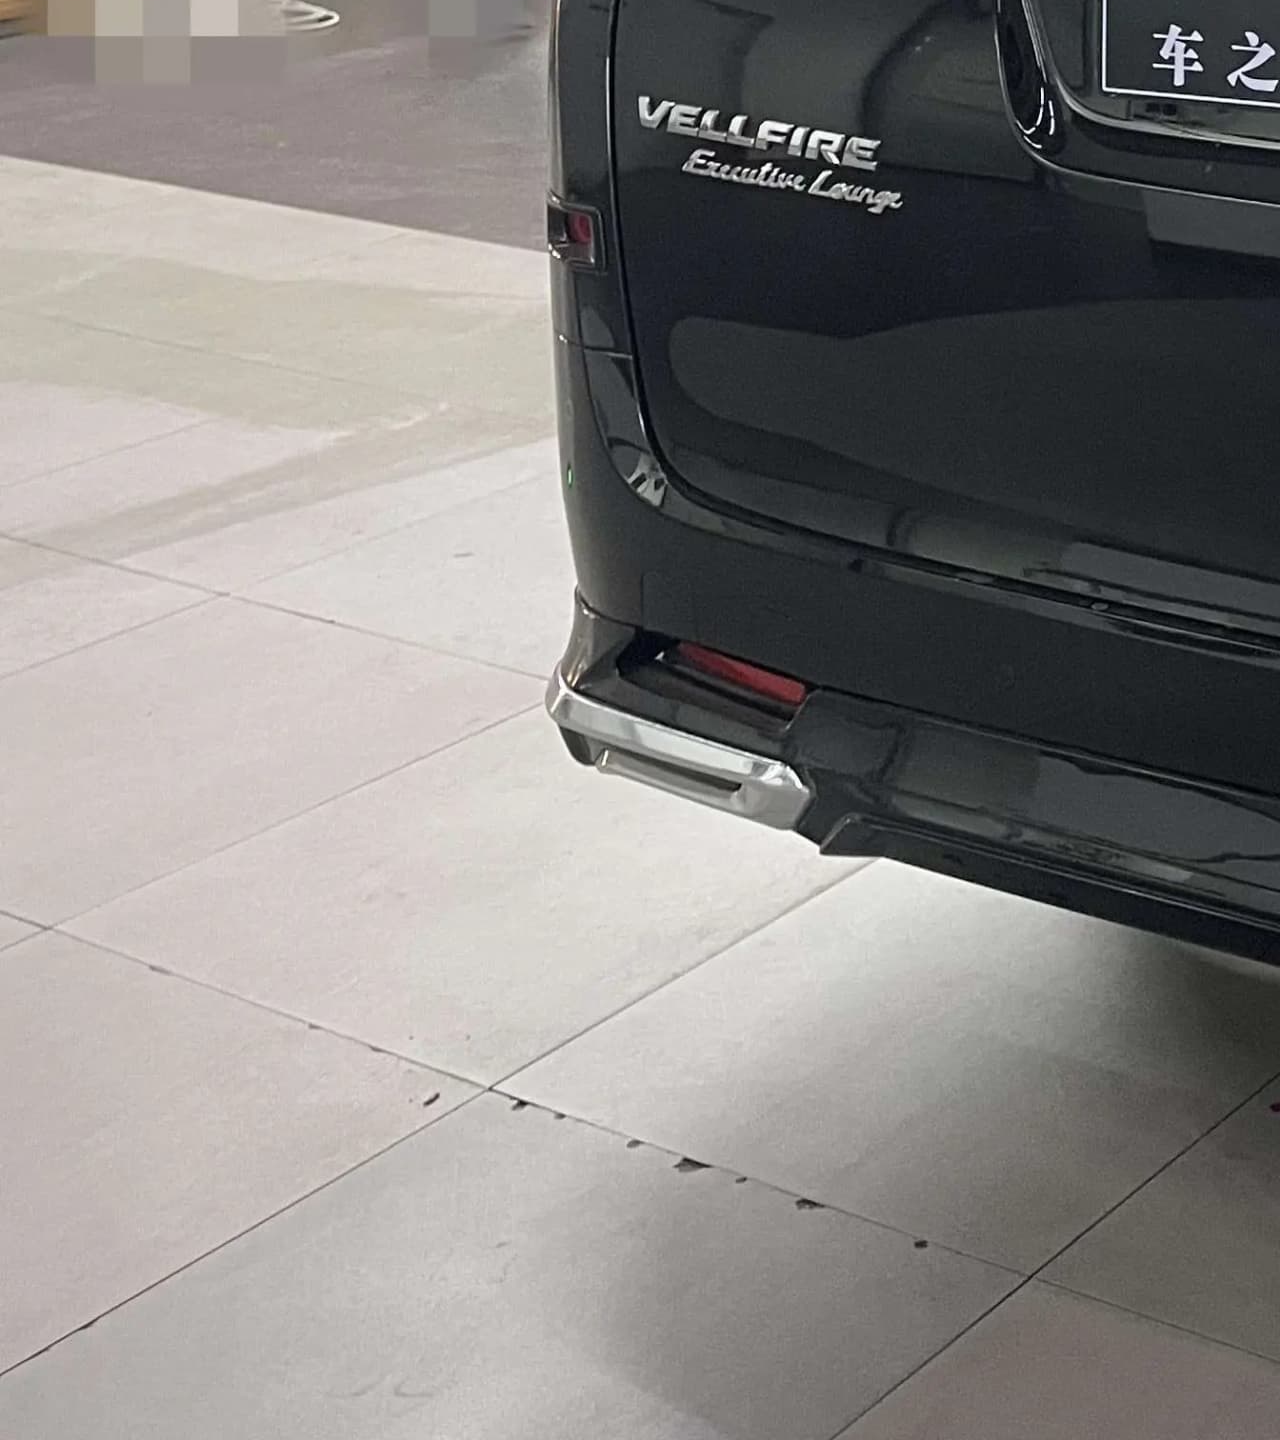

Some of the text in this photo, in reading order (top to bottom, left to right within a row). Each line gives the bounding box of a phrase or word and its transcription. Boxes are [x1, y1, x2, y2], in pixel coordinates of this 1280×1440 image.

[637, 95, 882, 172] VELLFIRE
[682, 149, 904, 214] Executive Lounge
